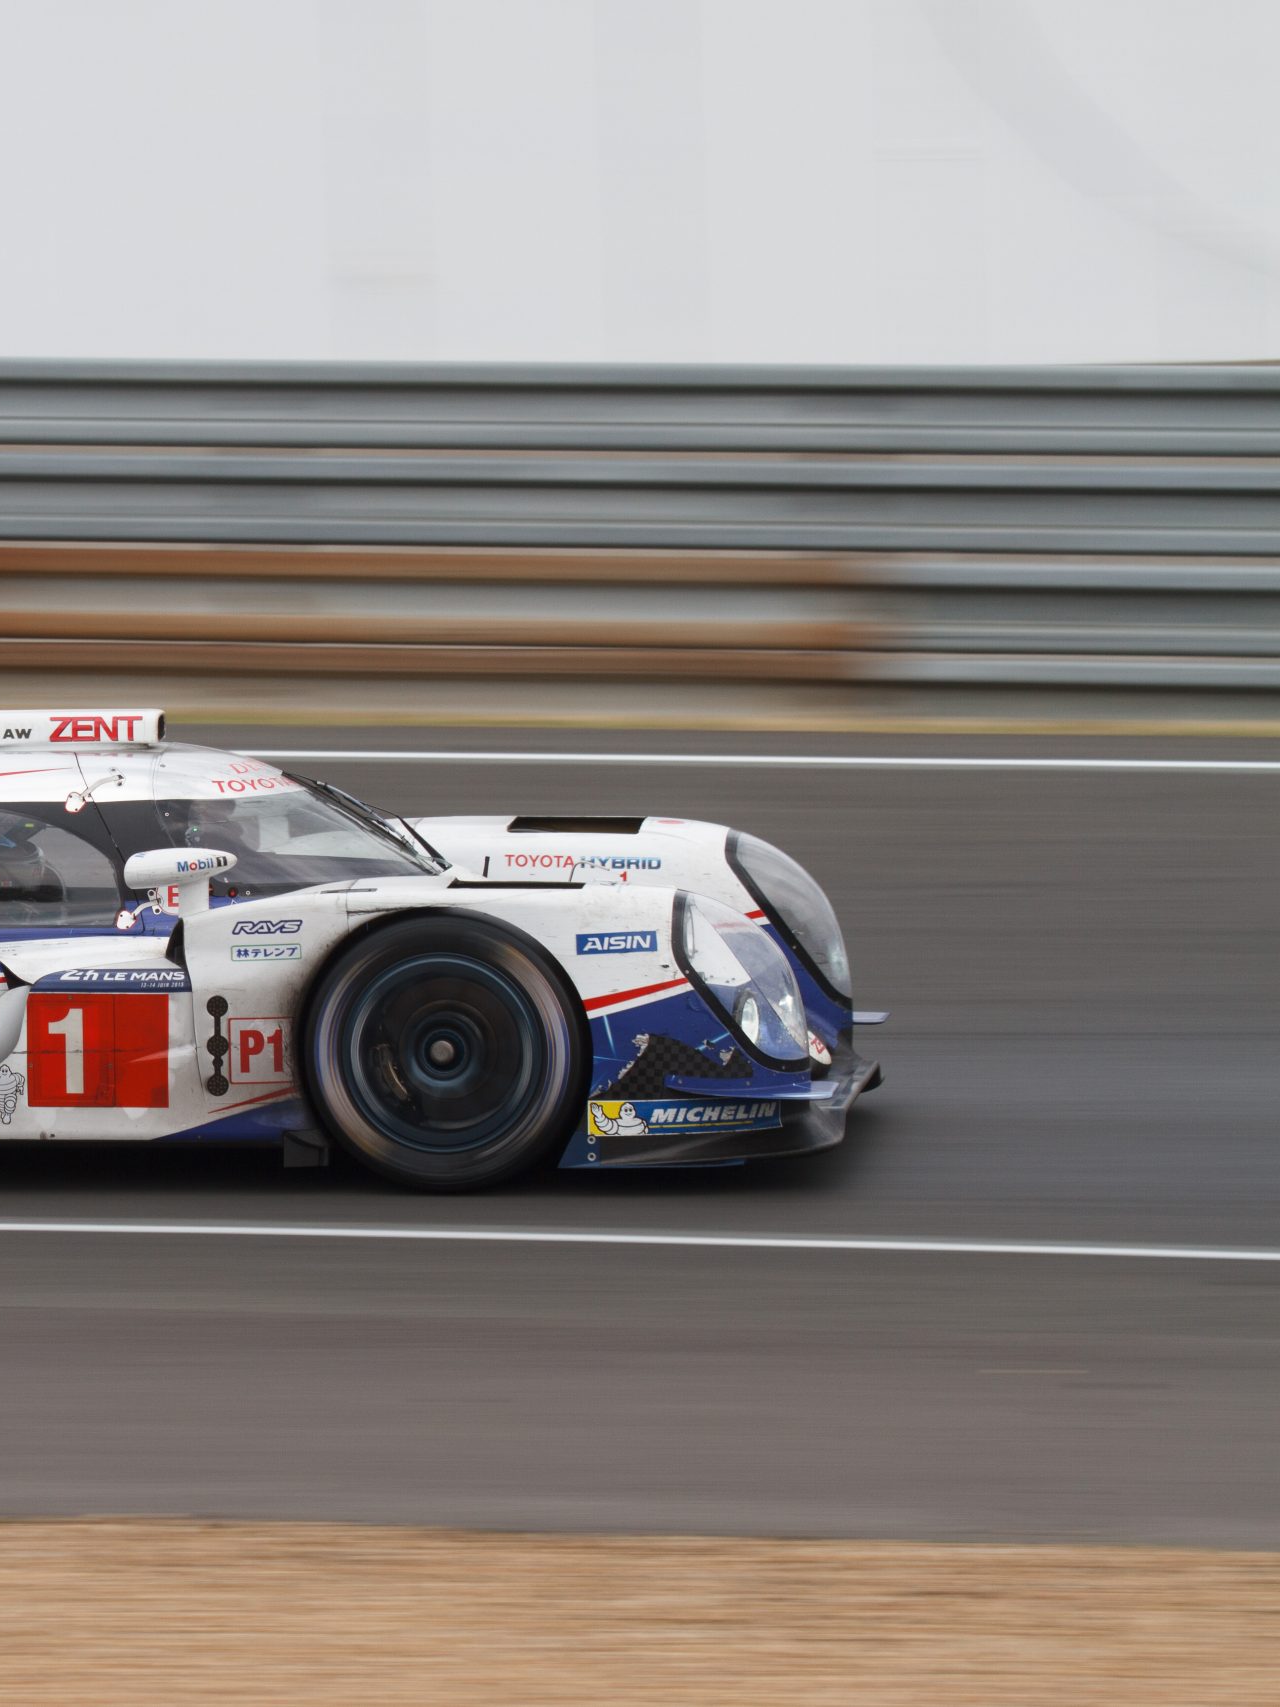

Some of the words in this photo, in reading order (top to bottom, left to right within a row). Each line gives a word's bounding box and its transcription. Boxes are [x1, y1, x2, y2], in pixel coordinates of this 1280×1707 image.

[2, 728, 32, 740] AW
[49, 715, 143, 742] ZENT
[177, 857, 214, 872] Mobil
[504, 854, 575, 868] TOYOTA
[580, 856, 662, 870] HYBRID
[232, 919, 303, 935] RAYS
[583, 935, 652, 951] AISIN
[103, 972, 127, 981] LE
[130, 971, 185, 981] MANS
[47, 1008, 84, 1095] 1
[239, 1028, 284, 1073] P1
[650, 1101, 777, 1124] MICHELIN
